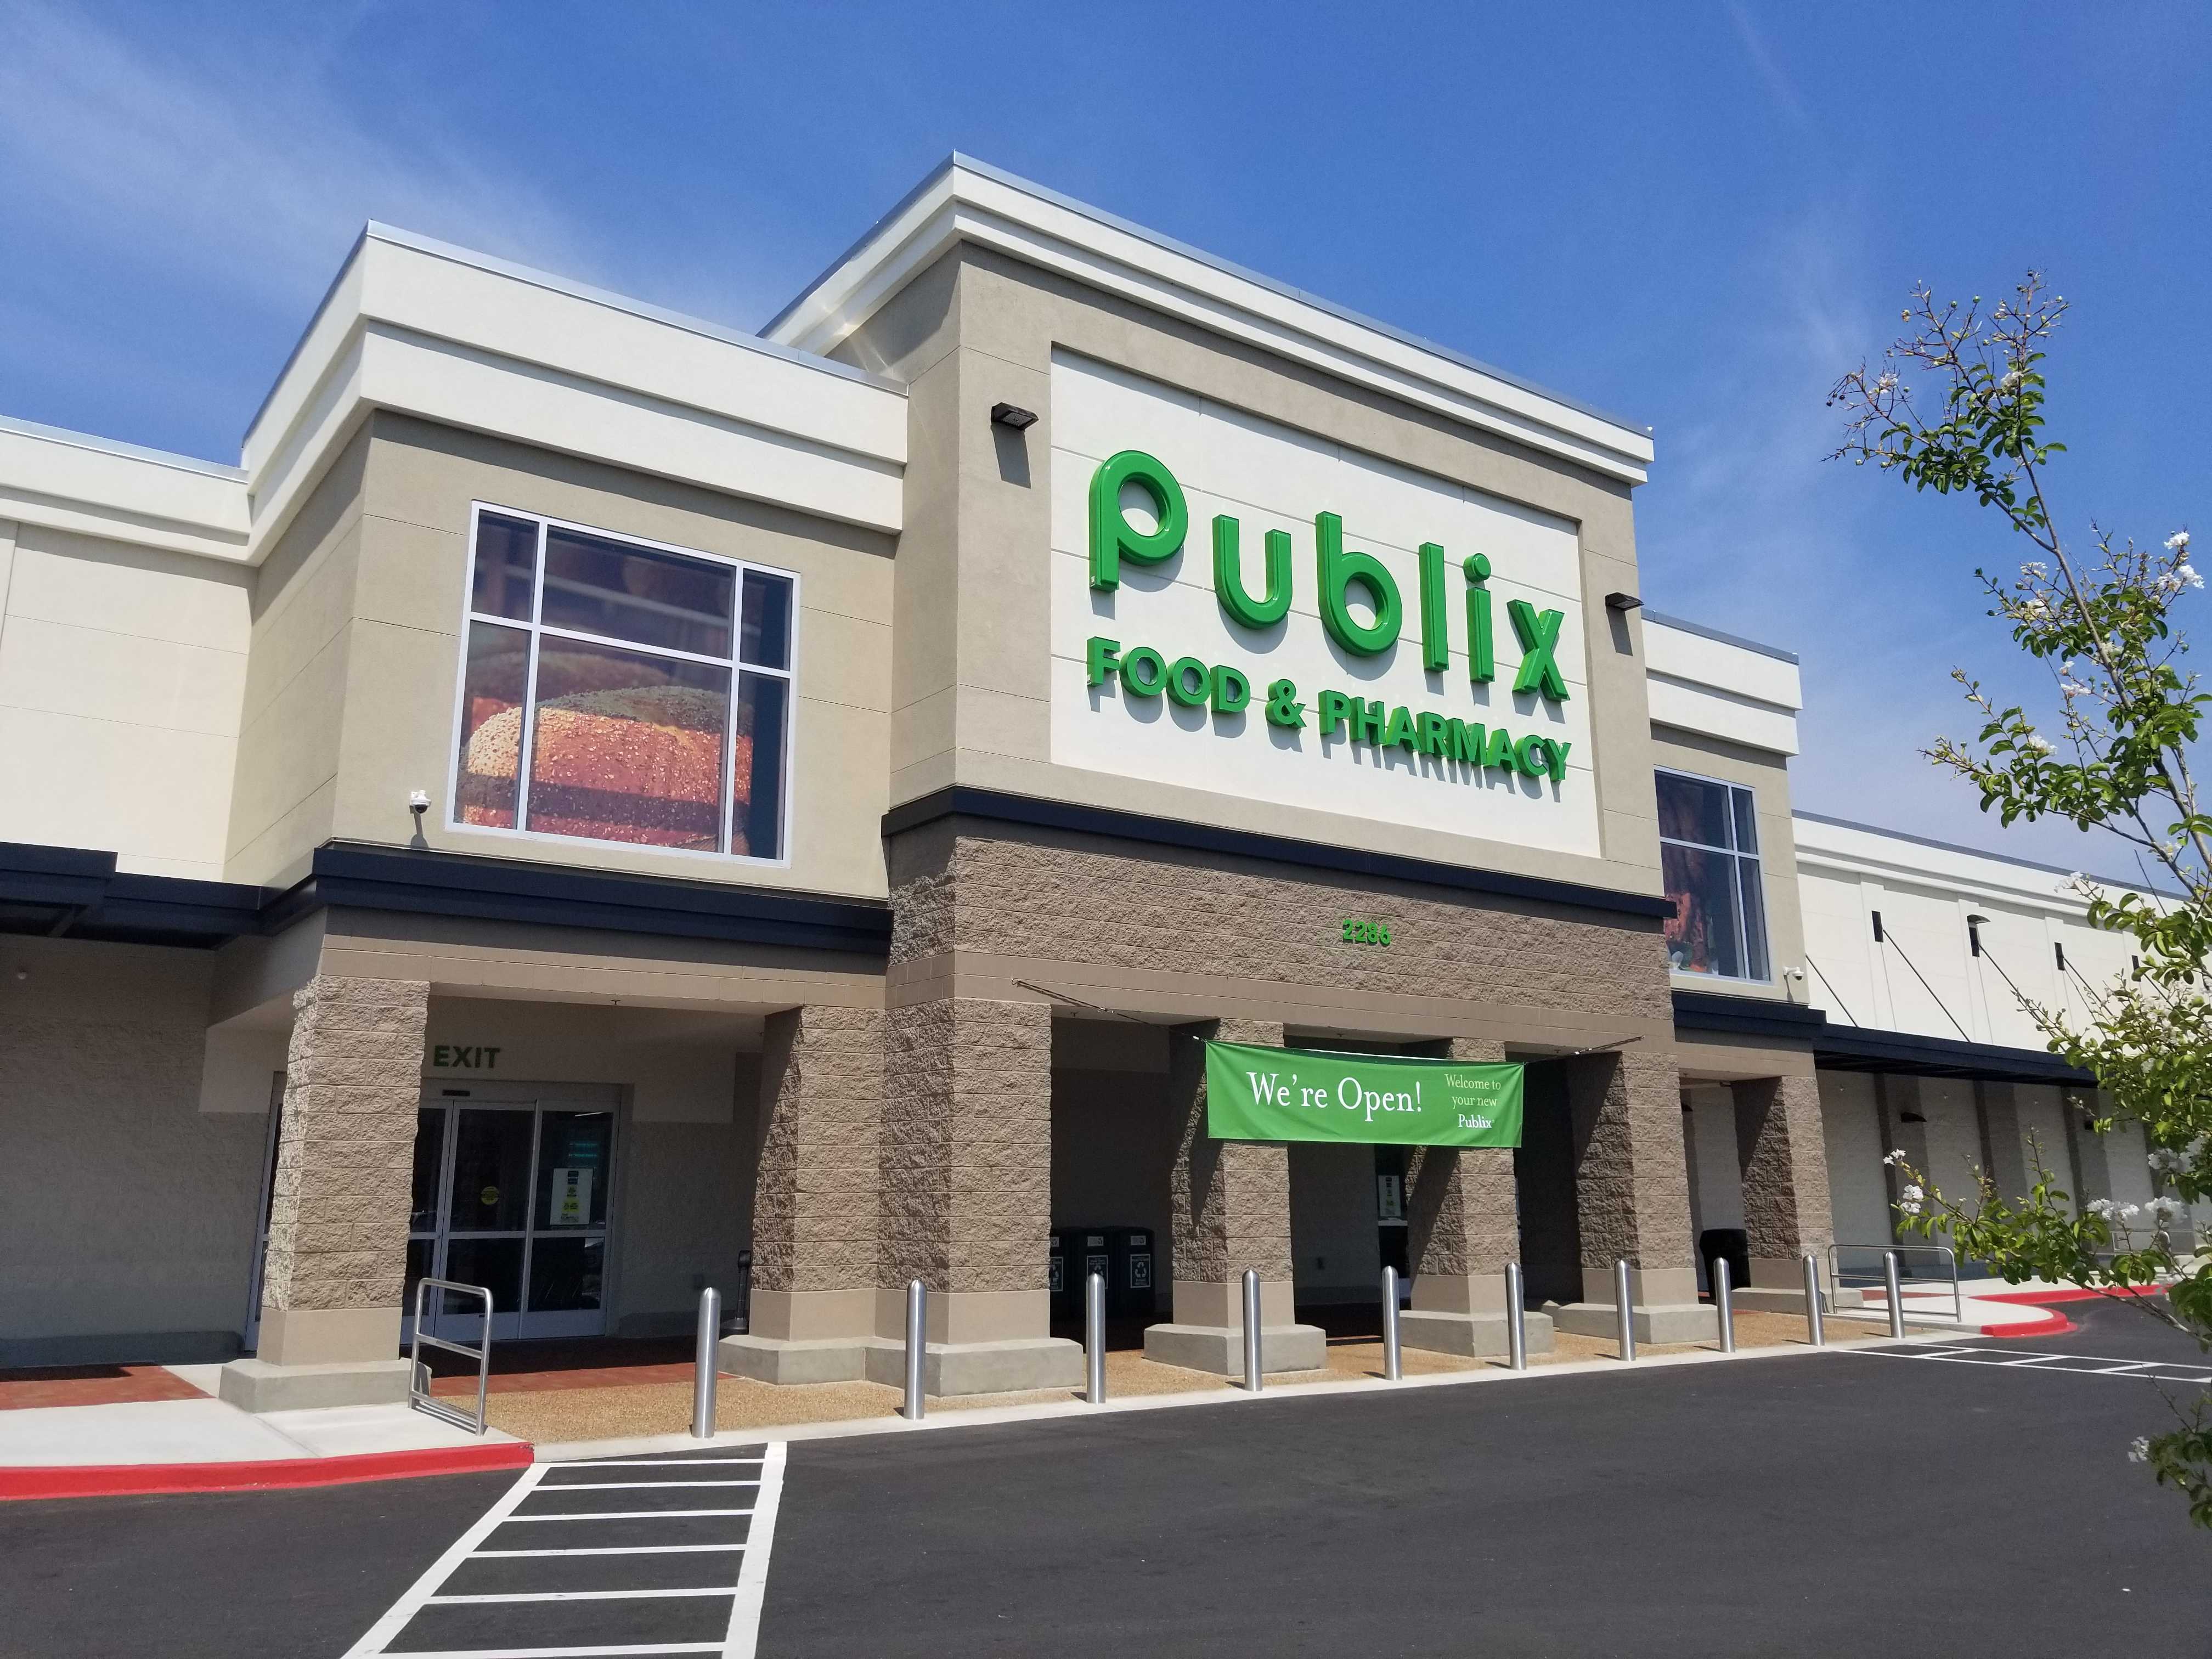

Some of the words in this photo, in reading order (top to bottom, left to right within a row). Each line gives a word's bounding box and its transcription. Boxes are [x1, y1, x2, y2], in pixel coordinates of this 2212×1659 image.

[1087, 636, 1251, 715] FOOD
[1265, 679, 1306, 729] &
[1318, 690, 1572, 782] PHARMACY
[1342, 919, 1391, 945] 2286
[433, 1045, 501, 1068] EXIT
[1444, 1074, 1490, 1090] Welcome
[1492, 1080, 1502, 1091] to
[1246, 1071, 1328, 1109] We're
[1337, 1076, 1422, 1122] Open!
[1452, 1096, 1475, 1110] your
[1477, 1097, 1497, 1107] new
[1458, 1114, 1492, 1128] Publix
